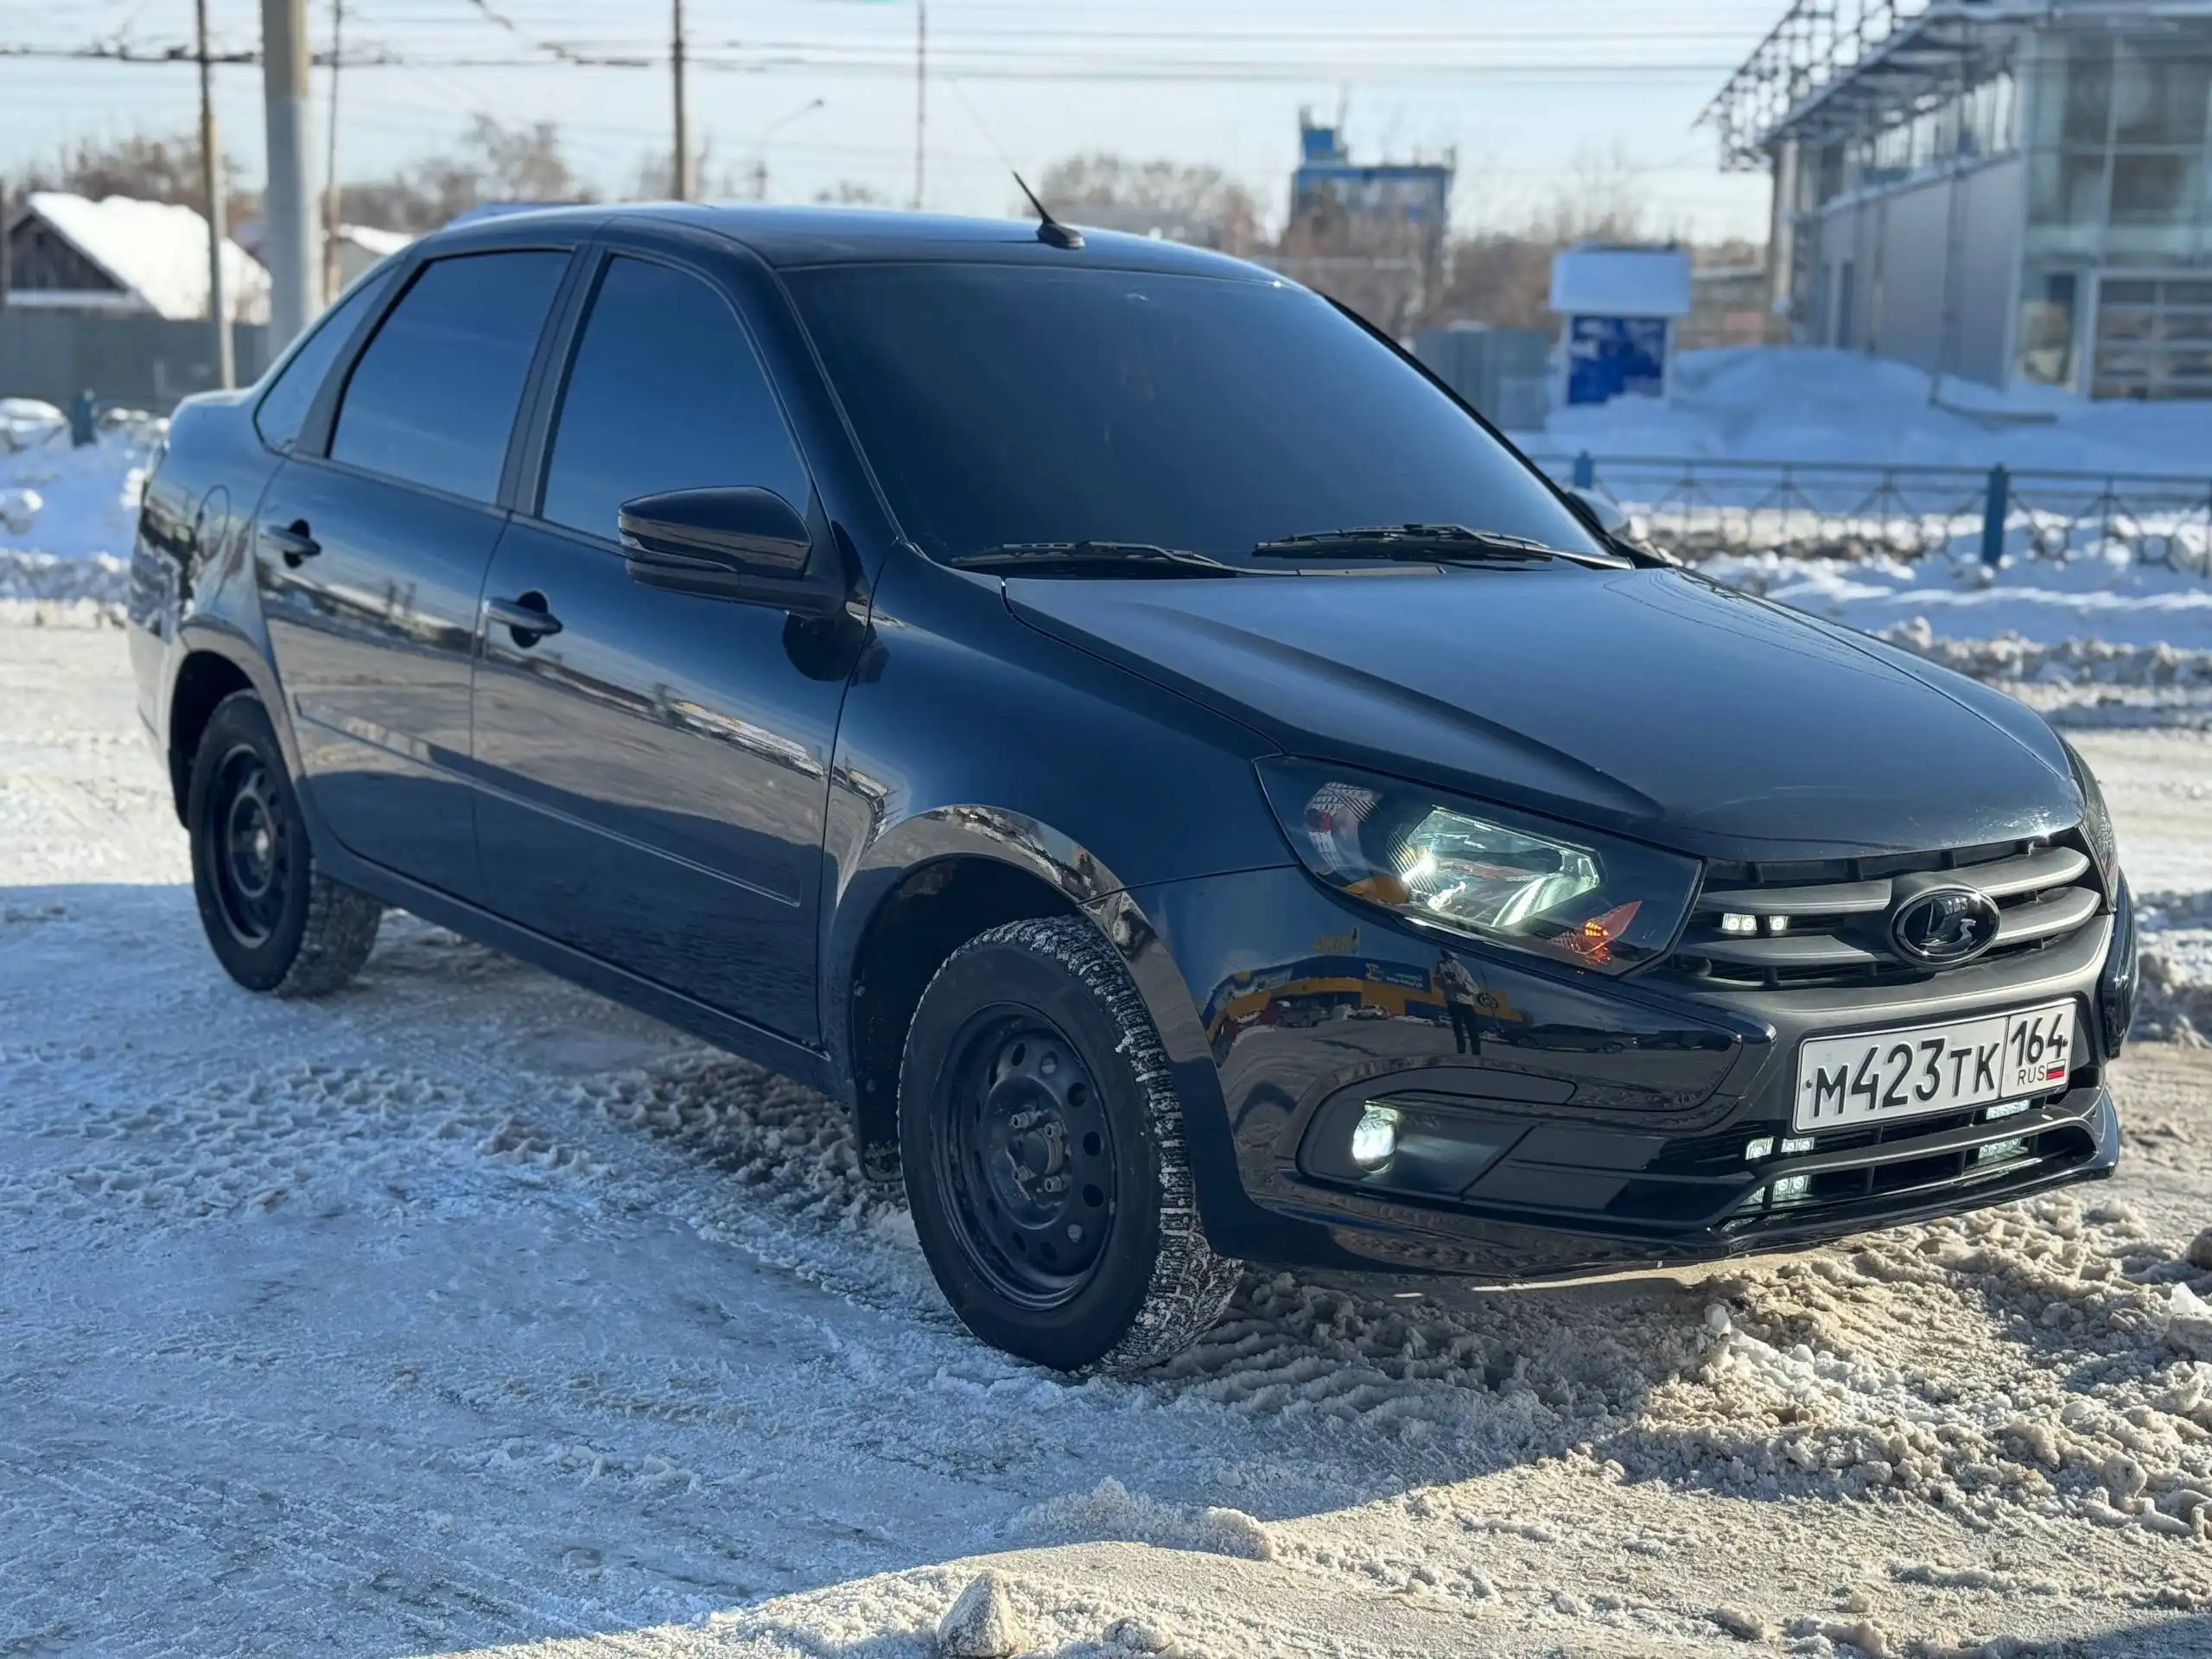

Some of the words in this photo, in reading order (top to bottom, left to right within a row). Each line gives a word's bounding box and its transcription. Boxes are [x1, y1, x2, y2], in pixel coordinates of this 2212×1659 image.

[1813, 1038, 2000, 1117] М423ТК
[2011, 1014, 2064, 1067] 164
[2017, 1065, 2045, 1086] RUS
